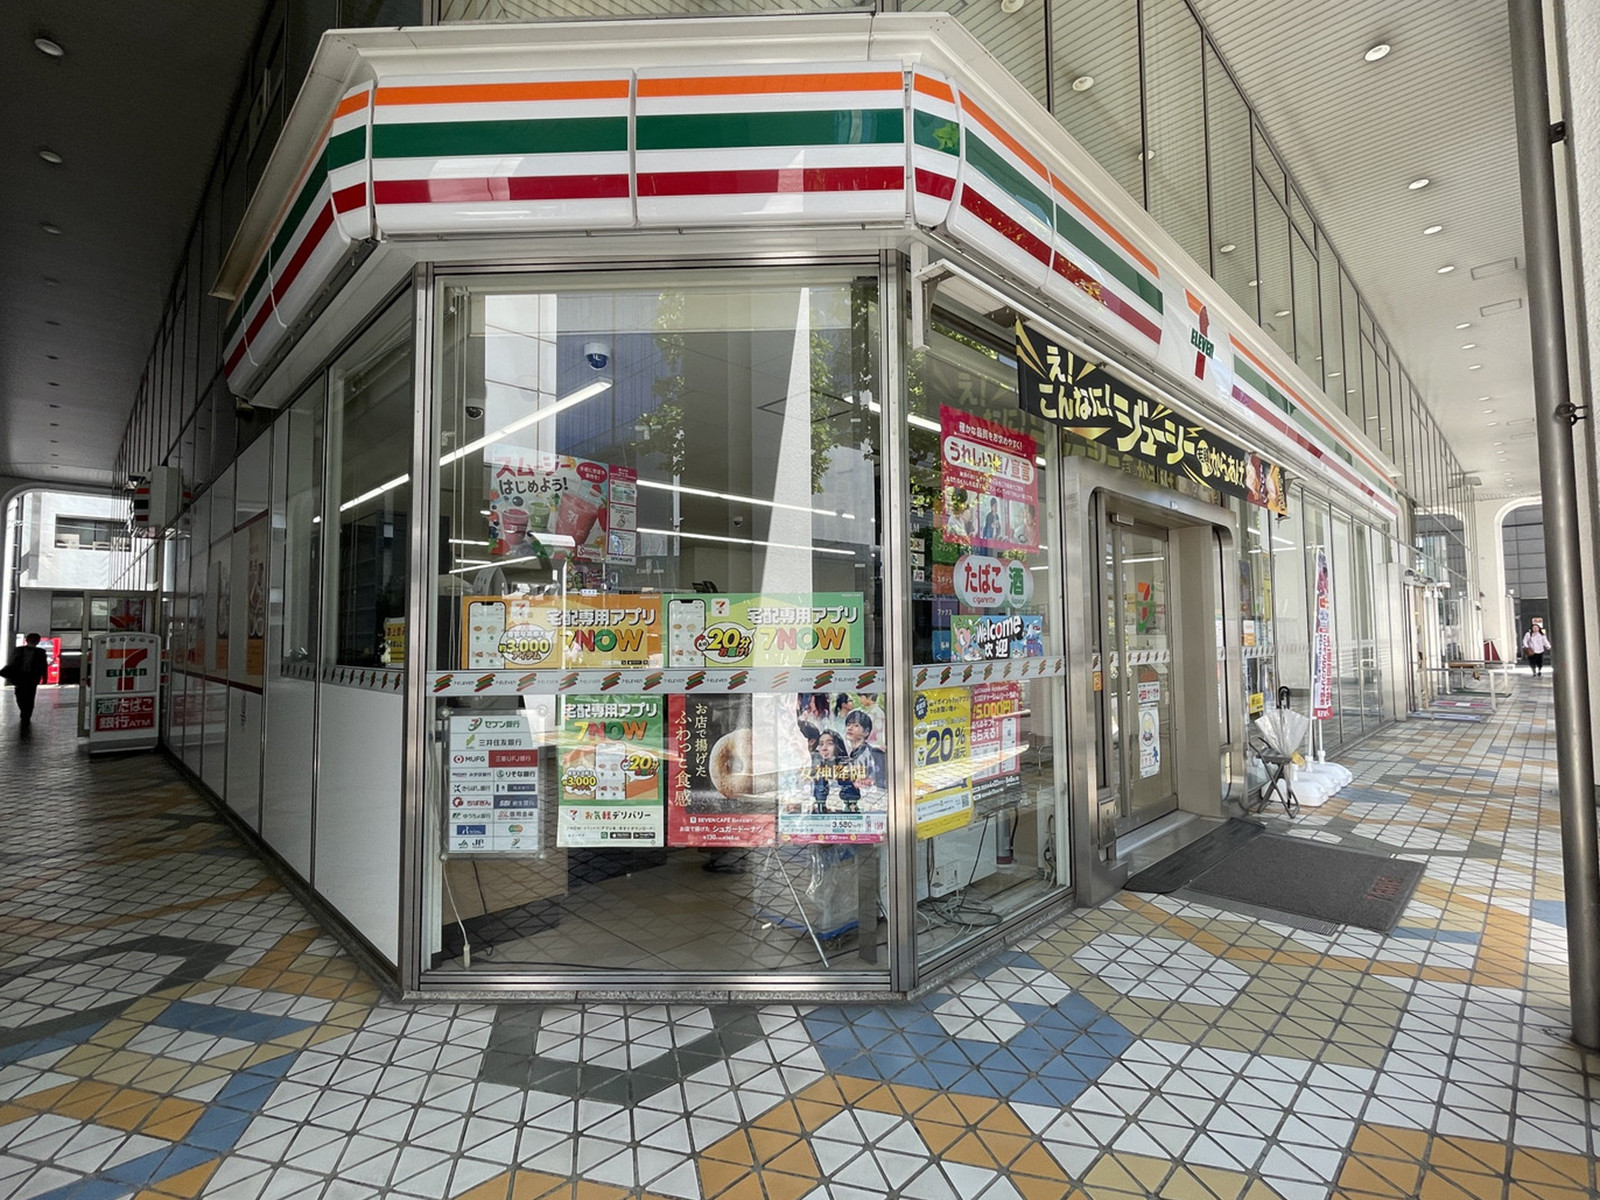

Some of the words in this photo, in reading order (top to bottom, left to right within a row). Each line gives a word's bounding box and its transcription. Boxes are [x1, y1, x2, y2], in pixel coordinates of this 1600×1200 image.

[1046, 344, 1074, 385] え!
[1038, 383, 1114, 421] こんなに!
[1113, 393, 1196, 466] ジューシー
[499, 476, 569, 496] はじめよう!
[965, 563, 1003, 594] たばこ
[1009, 567, 1024, 596] 酒
[547, 608, 656, 627] 宅配専用アプリ
[747, 606, 859, 625] 宅配専用アプリ
[758, 626, 847, 651] 7NOW
[976, 615, 1023, 643] Welcome
[560, 628, 645, 652] 7NOW
[118, 698, 153, 713] たばこ
[565, 702, 658, 720] 宅配専用アプリ
[485, 720, 520, 728] セブン銀行
[573, 720, 648, 741] 7NOW
[479, 739, 522, 747] 三井住友銀行
[694, 703, 708, 777] お店で揚げた
[971, 727, 999, 742] もらえる!
[674, 710, 692, 807] ふわっと食感
[505, 770, 536, 778] りそな銀行
[800, 764, 867, 781] 女神降臨
[584, 810, 652, 821] お気軽デリバリー
